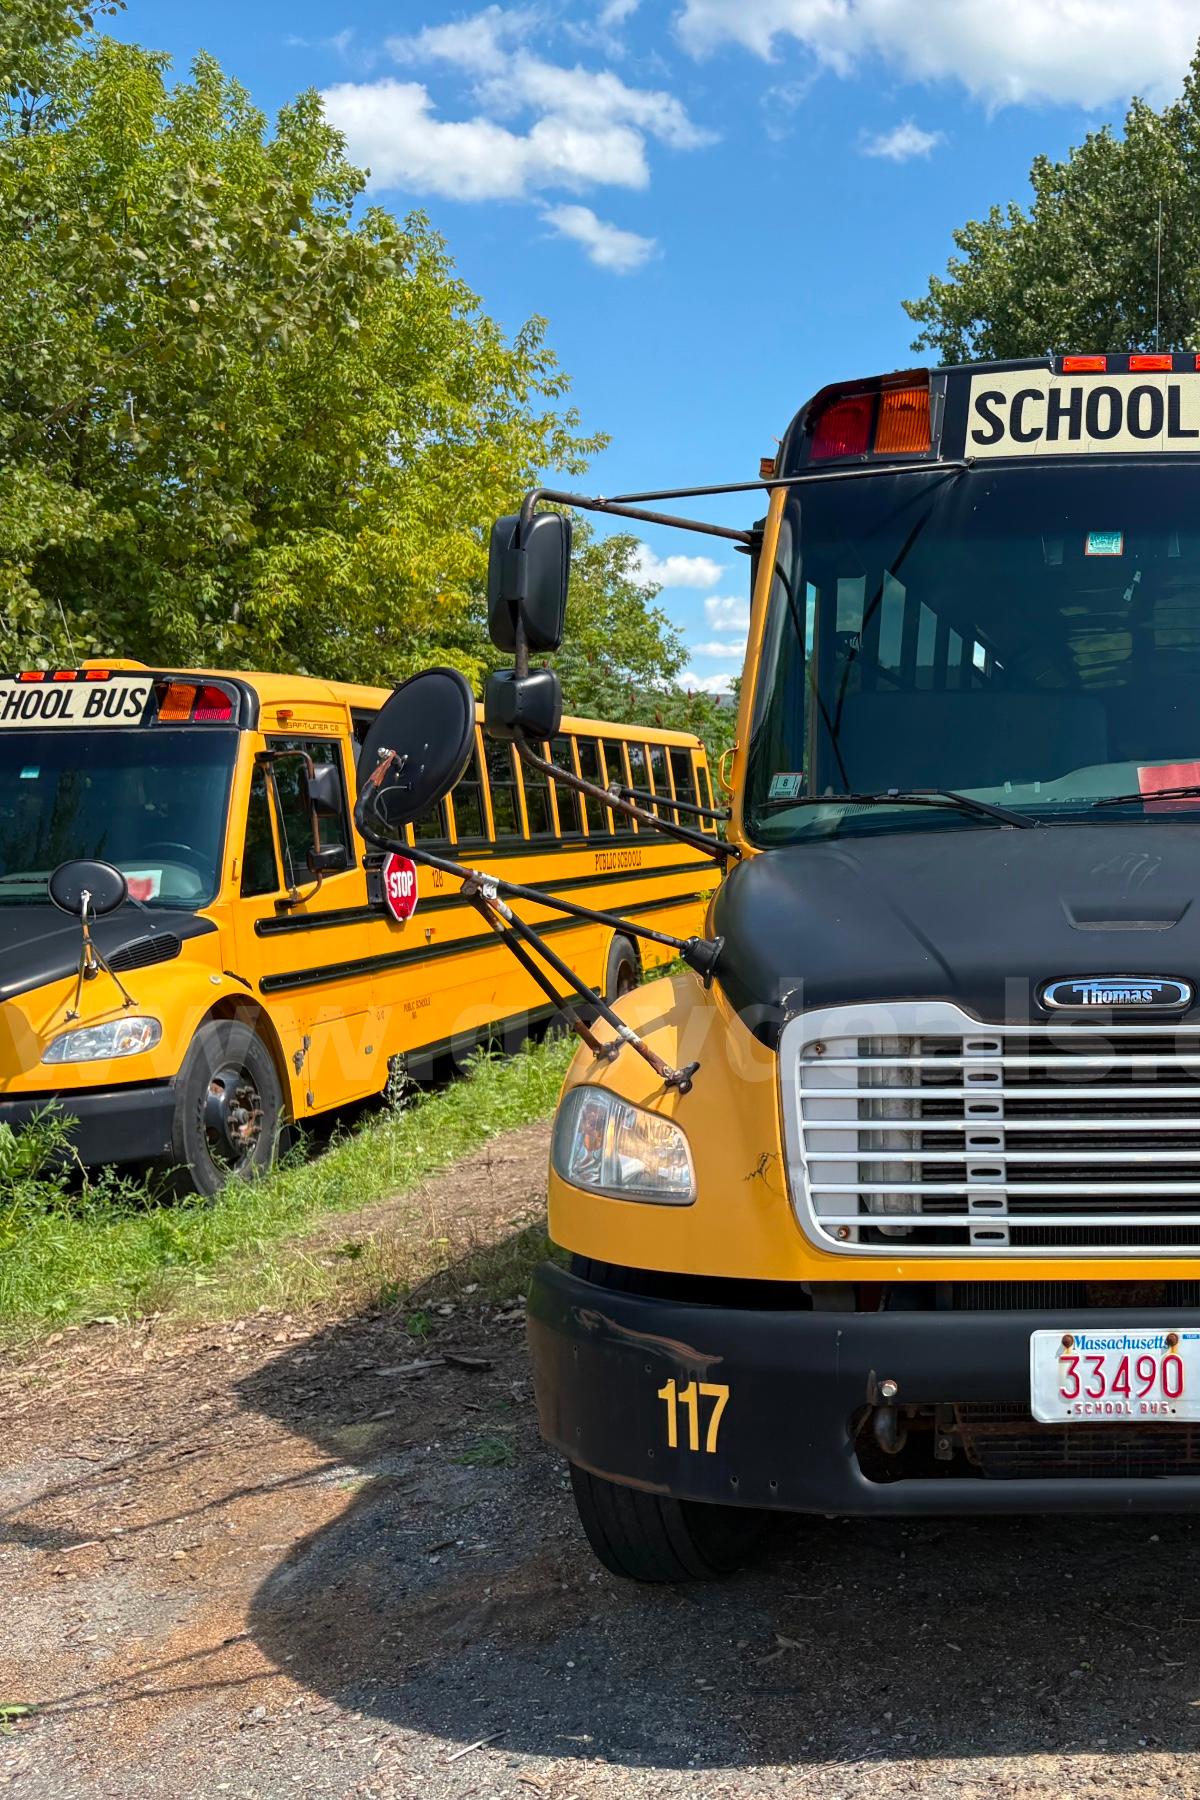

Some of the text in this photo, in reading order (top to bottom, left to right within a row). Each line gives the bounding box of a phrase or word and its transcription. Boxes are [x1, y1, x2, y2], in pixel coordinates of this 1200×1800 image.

[971, 385, 1199, 445] SCHOOL
[0, 687, 147, 720] HOOL BUS
[595, 850, 642, 871] PUBLIC SCHOOLS
[390, 870, 414, 899] STOP
[1072, 983, 1162, 1005] Thomas
[1074, 1334, 1169, 1351] Massachusetts
[1059, 1355, 1183, 1399] 33490
[658, 1378, 730, 1454] 117
[1073, 1402, 1169, 1415] SCHOOL BUS
